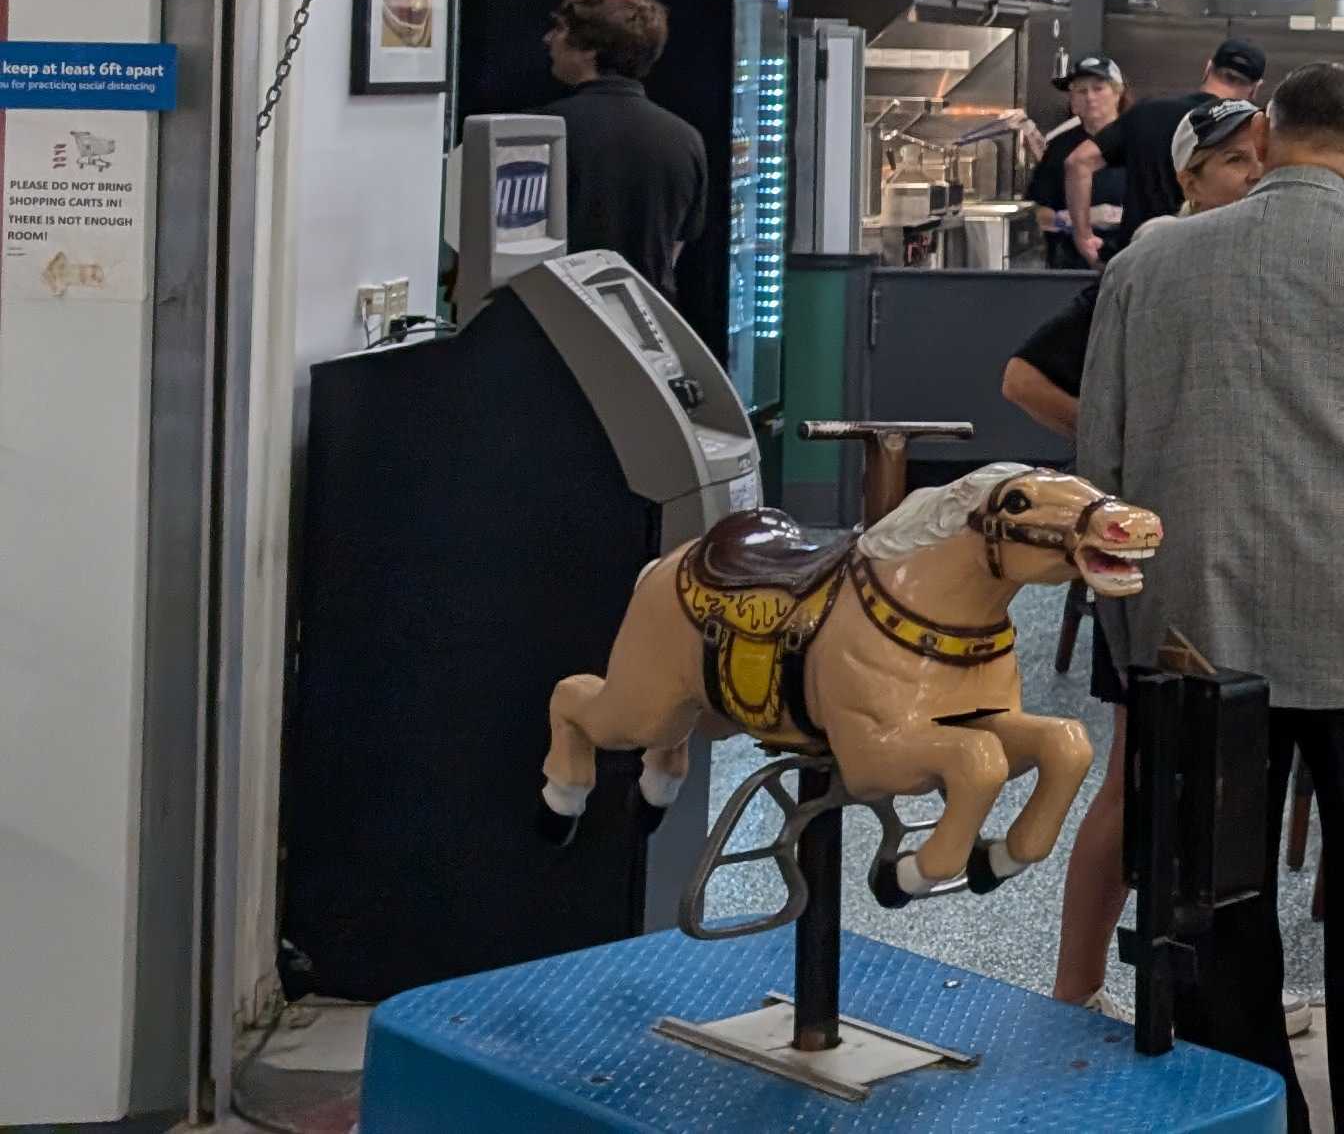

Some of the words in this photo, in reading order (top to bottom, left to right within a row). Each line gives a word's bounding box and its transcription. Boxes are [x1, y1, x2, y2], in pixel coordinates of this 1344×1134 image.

[3, 60, 38, 78] keep
[42, 63, 57, 76] at
[61, 61, 96, 76] least
[99, 62, 122, 76] 6ft
[125, 64, 164, 79] apart
[11, 79, 25, 89] for
[28, 80, 77, 92] practicing
[79, 80, 106, 90] social
[107, 80, 155, 93] distancing
[10, 180, 49, 191] PLEASE
[51, 181, 68, 191] DO
[71, 181, 95, 192] NOT
[98, 182, 133, 193] BRING
[9, 196, 66, 207] SHOPPING
[68, 197, 103, 208] CARTS
[106, 198, 122, 208] IN!
[8, 215, 42, 225] THERE
[46, 216, 55, 226] IS
[58, 216, 82, 226] NOT
[85, 217, 133, 227] ENOUGH
[7, 231, 48, 241] ROOM!
